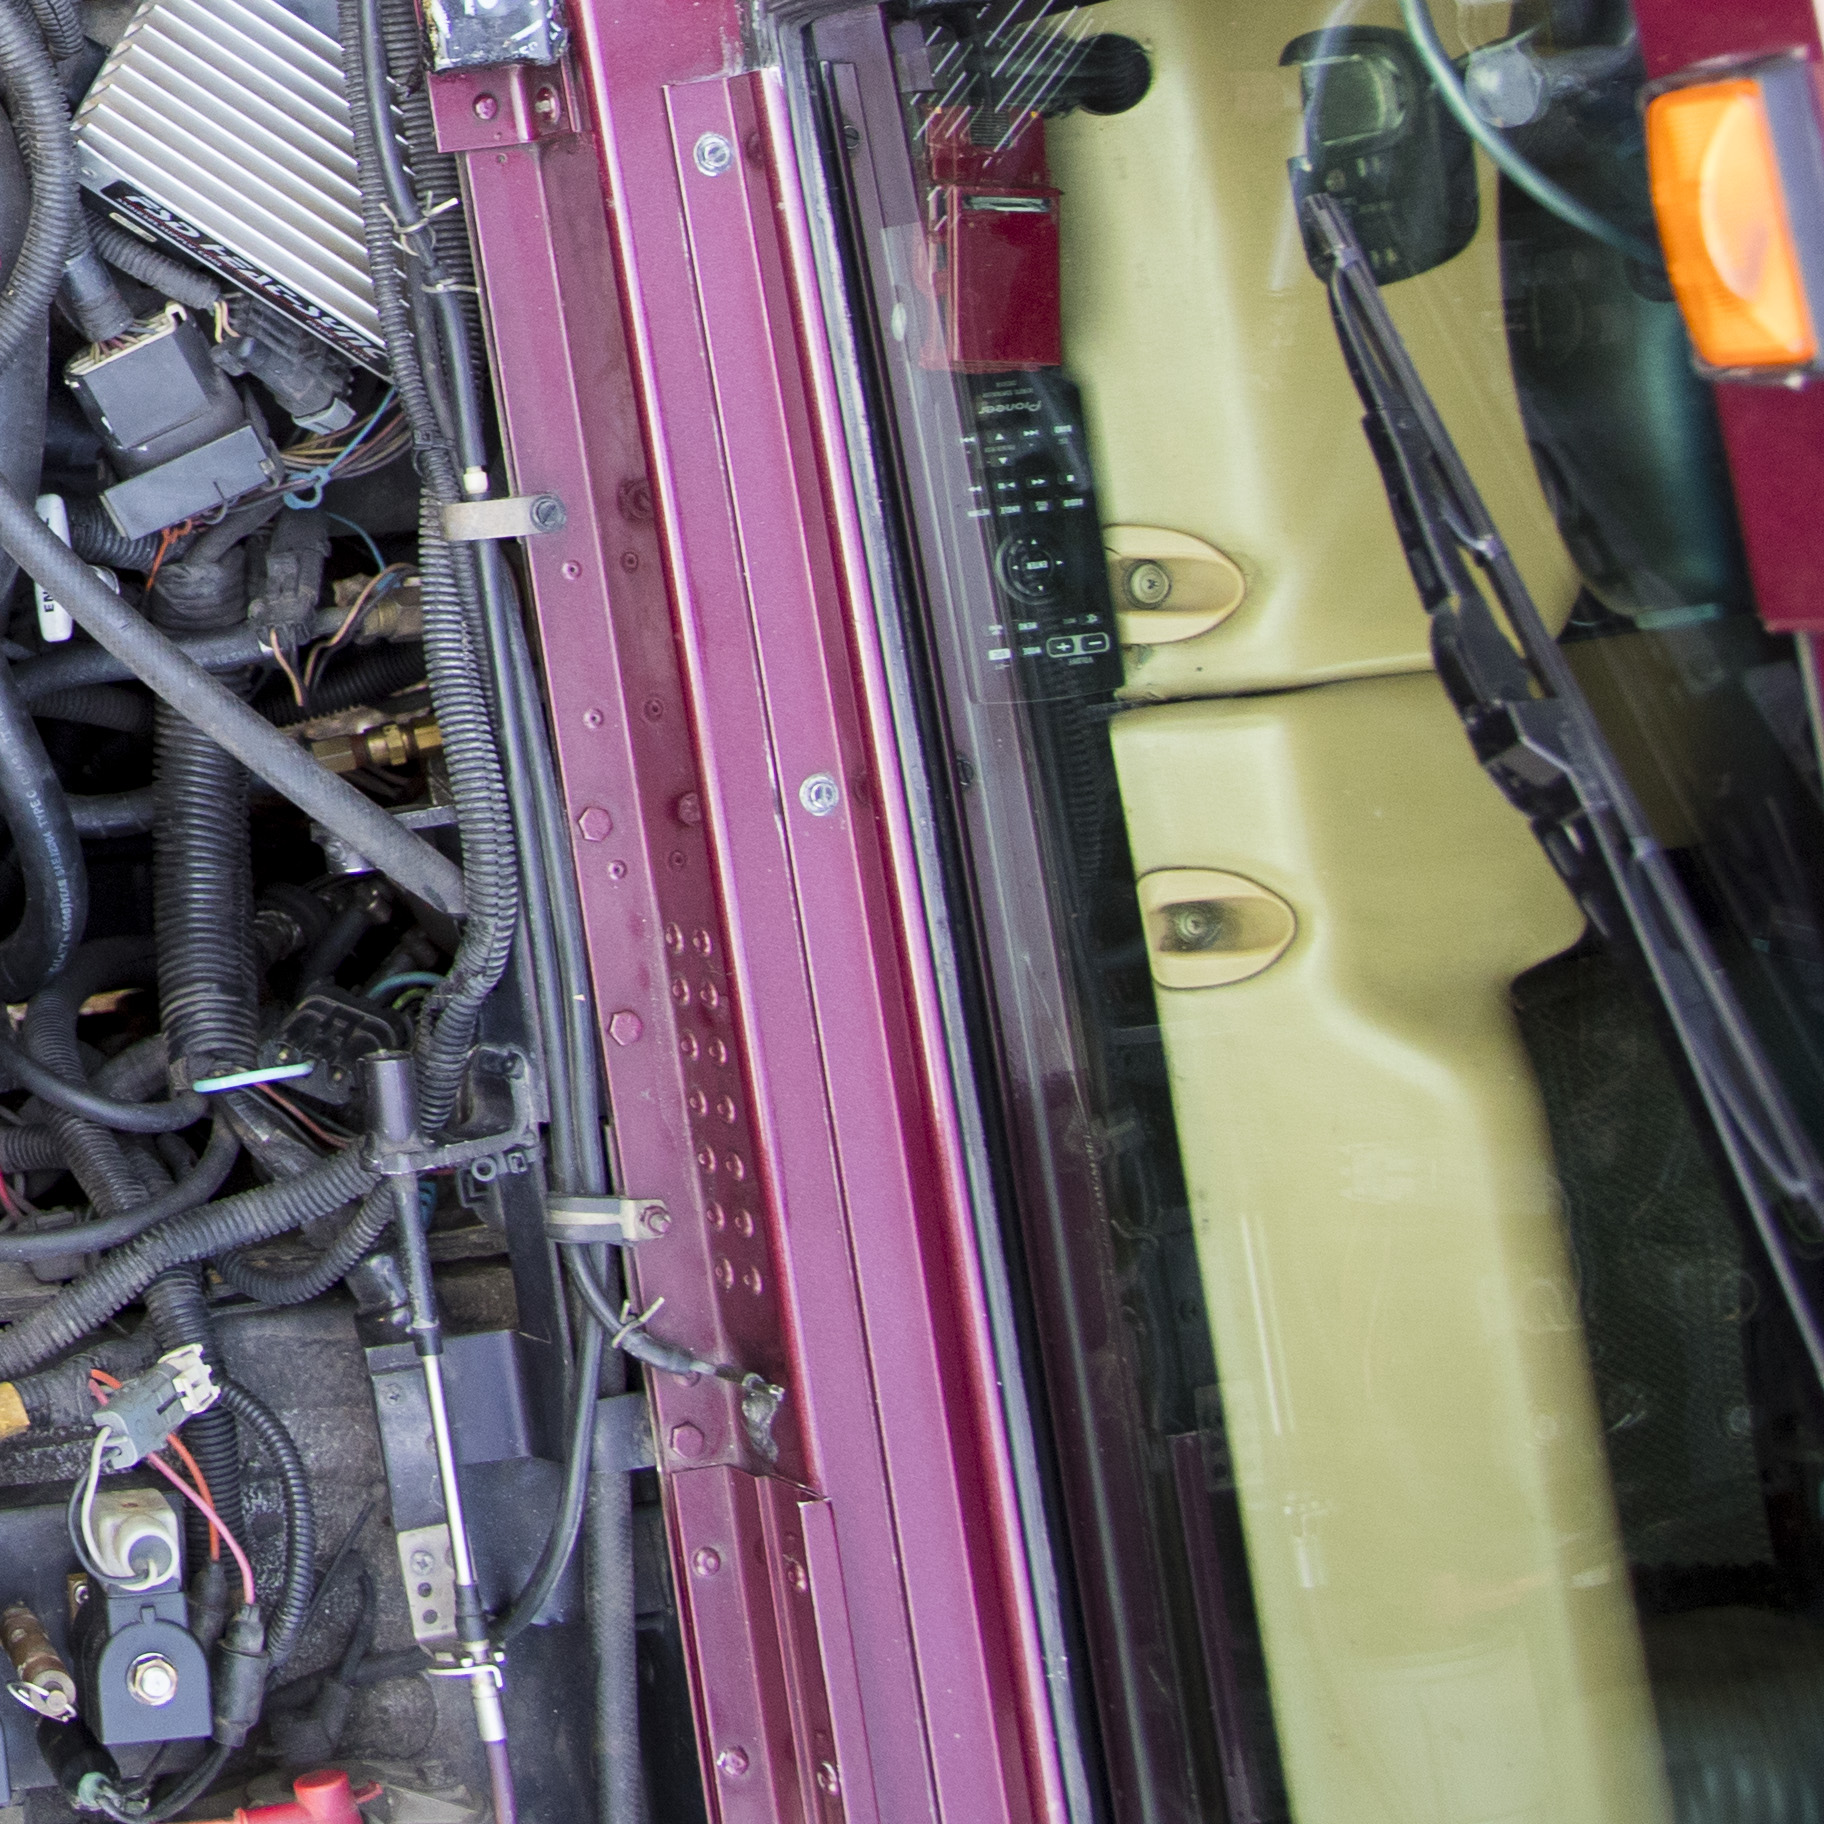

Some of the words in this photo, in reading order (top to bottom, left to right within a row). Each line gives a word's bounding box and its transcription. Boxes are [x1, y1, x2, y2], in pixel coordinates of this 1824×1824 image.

[124, 194, 201, 239] FSD
[976, 399, 1041, 415] Pioneer
[30, 798, 48, 826] TYPE
